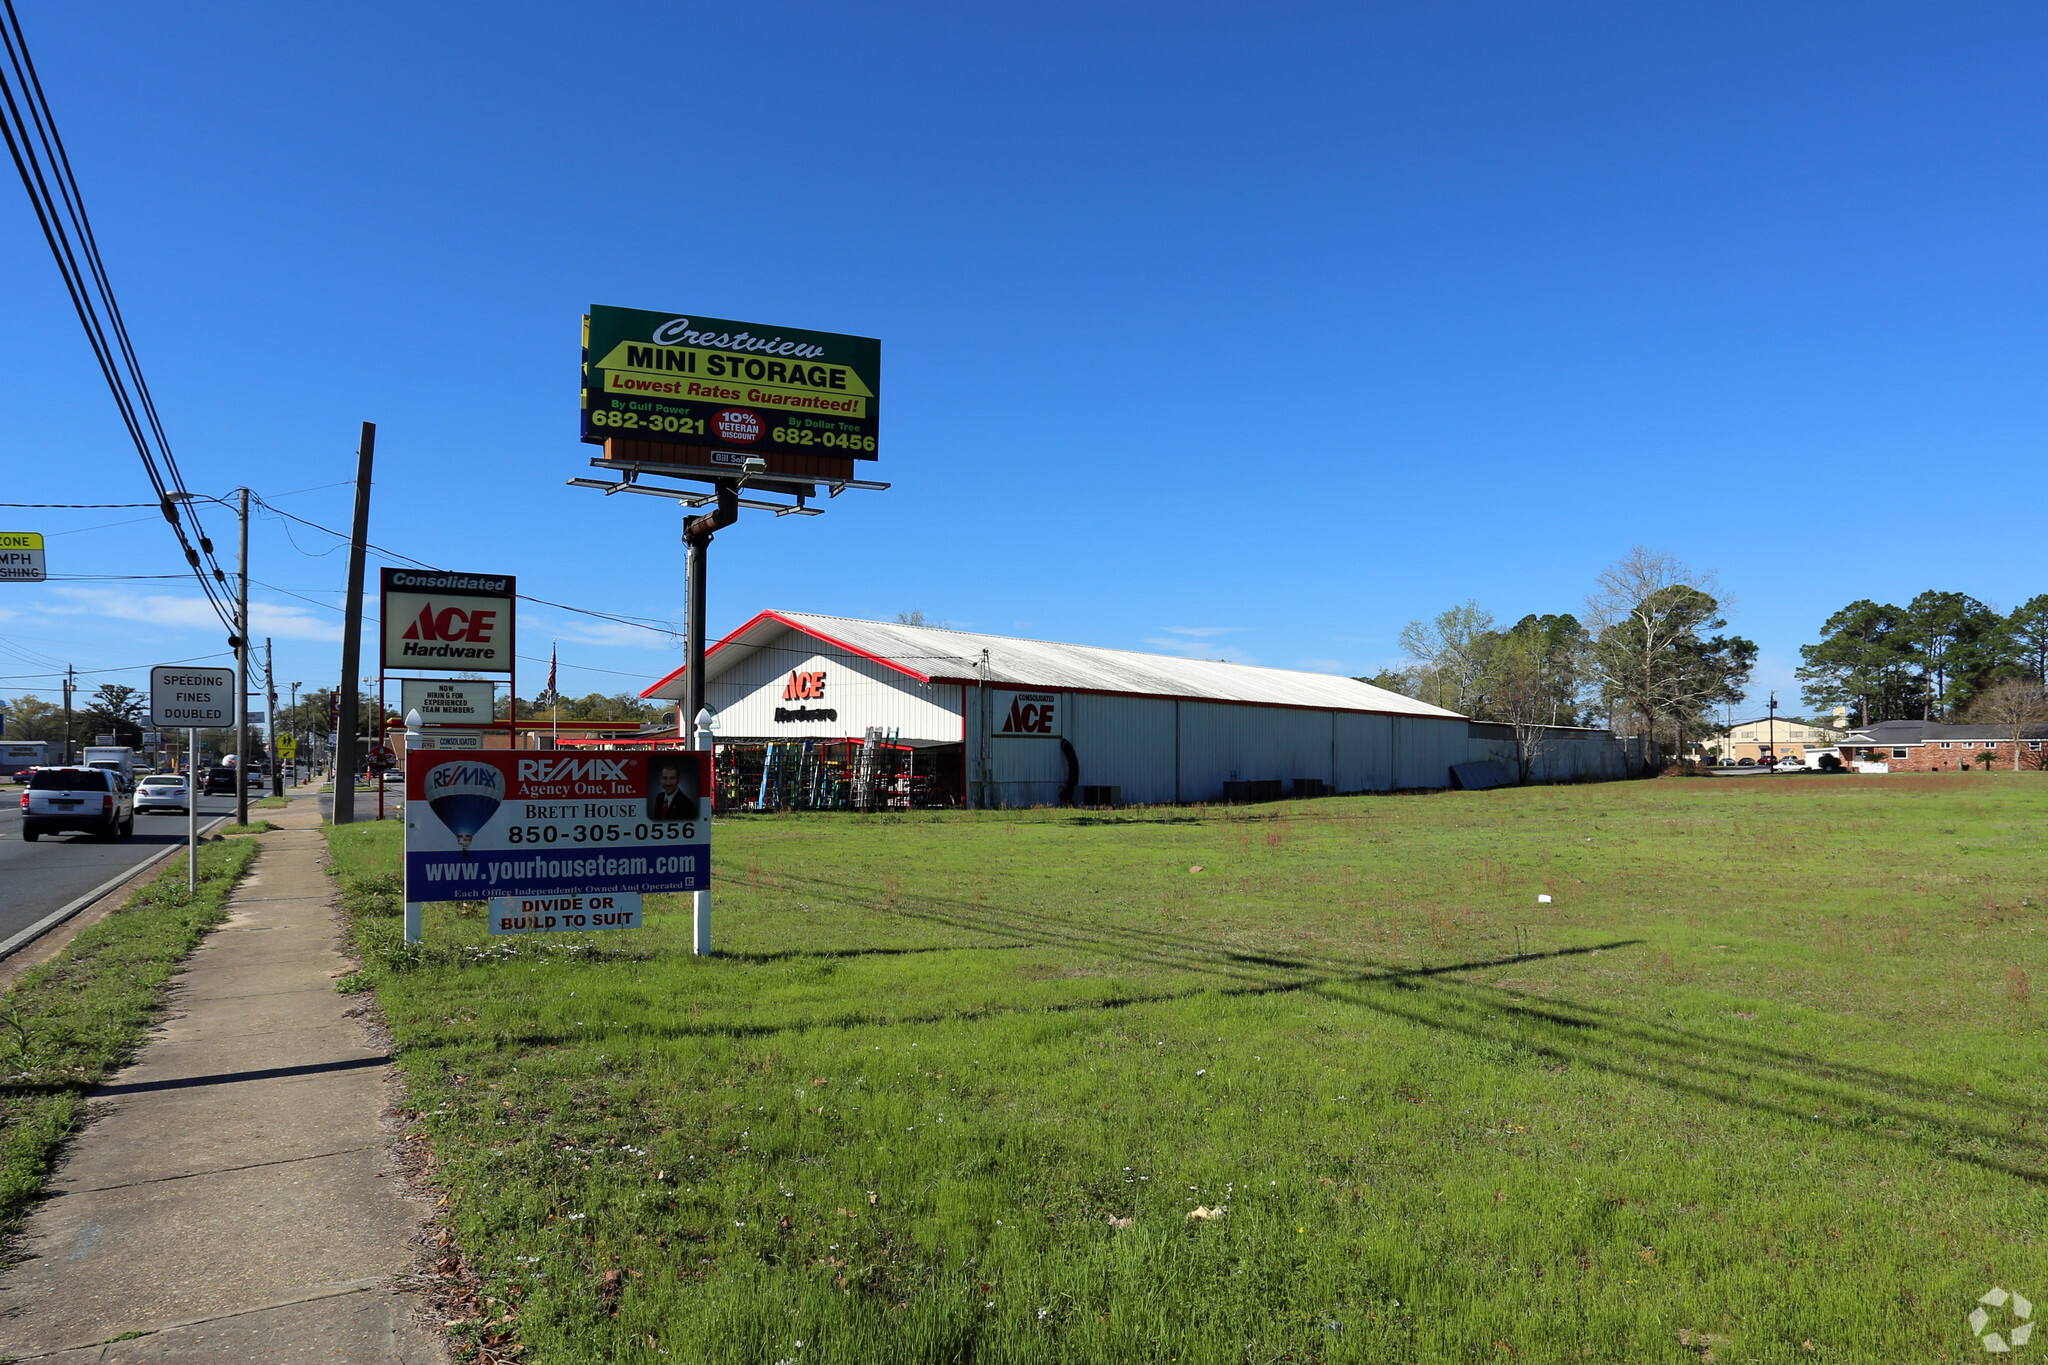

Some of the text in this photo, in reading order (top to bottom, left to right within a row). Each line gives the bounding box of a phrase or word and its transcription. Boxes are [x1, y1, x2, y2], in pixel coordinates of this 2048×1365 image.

[652, 318, 824, 358] Crestview
[627, 346, 846, 389] MINI STORAGE
[612, 374, 858, 413] Lowest Rates Guaranteed!
[611, 399, 690, 415] By Gulf Power
[592, 410, 705, 434] 682-3021
[722, 412, 756, 424] 10%
[788, 417, 860, 432] By Dollar Tree
[718, 421, 759, 433] VETERAN
[721, 431, 756, 441] DISCOUNT
[773, 427, 875, 451] 682-0456
[716, 453, 728, 462] Bill
[393, 573, 506, 591] Consolidated
[402, 602, 496, 642] ACE
[403, 642, 495, 658] Hardware
[163, 676, 223, 686] SPEEDING
[782, 670, 826, 701] ACE
[176, 693, 211, 702] FINES
[1018, 694, 1054, 702] CONSOLIDATED
[165, 709, 221, 719] DOUBLED
[774, 705, 837, 723] Hardware
[1002, 695, 1054, 733] ACE
[440, 738, 476, 746] CONSOLIDATED
[433, 766, 497, 789] RE/MAX
[518, 758, 629, 782] RE/MAX
[518, 782, 636, 798] Agency One, Inc.
[525, 803, 637, 819] BRETT HOUSE
[508, 823, 695, 843] 850-305-0556
[426, 855, 695, 884] www.yourhouseteam.com
[482, 888, 512, 896] Office
[514, 886, 582, 896] Independently
[585, 884, 619, 892] Owned
[622, 883, 639, 891] And
[642, 881, 683, 891] Operated
[521, 897, 614, 912] DIVIDE OR
[501, 912, 633, 930] BUILD TO SUIT
